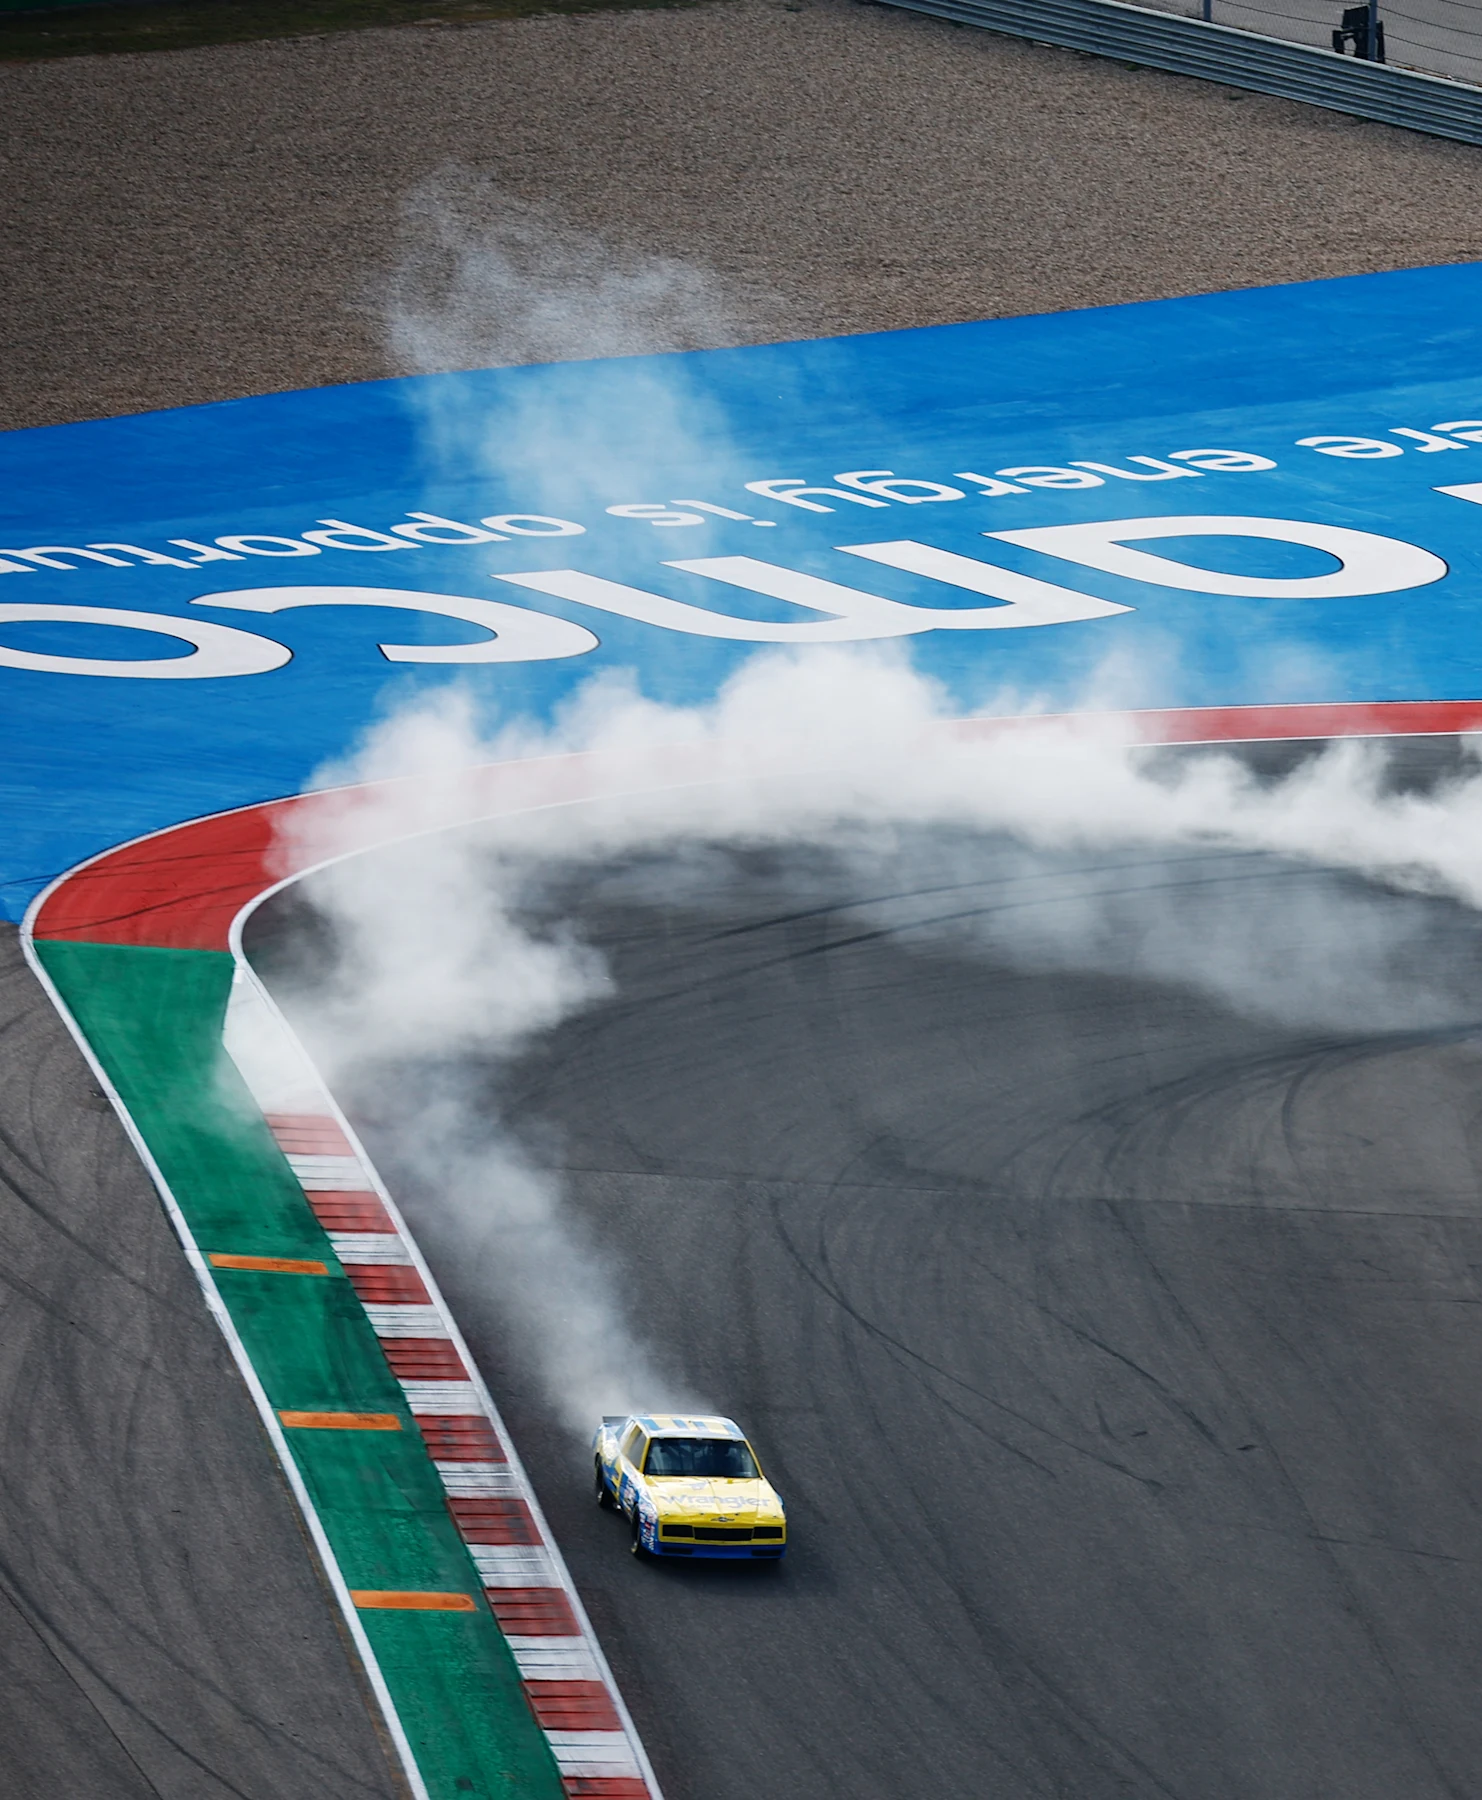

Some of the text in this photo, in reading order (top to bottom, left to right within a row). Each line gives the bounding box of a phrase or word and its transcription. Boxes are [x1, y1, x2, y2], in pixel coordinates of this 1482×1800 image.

[743, 448, 1278, 513] energy
[0, 512, 588, 574] opportu
[604, 499, 778, 528] is
